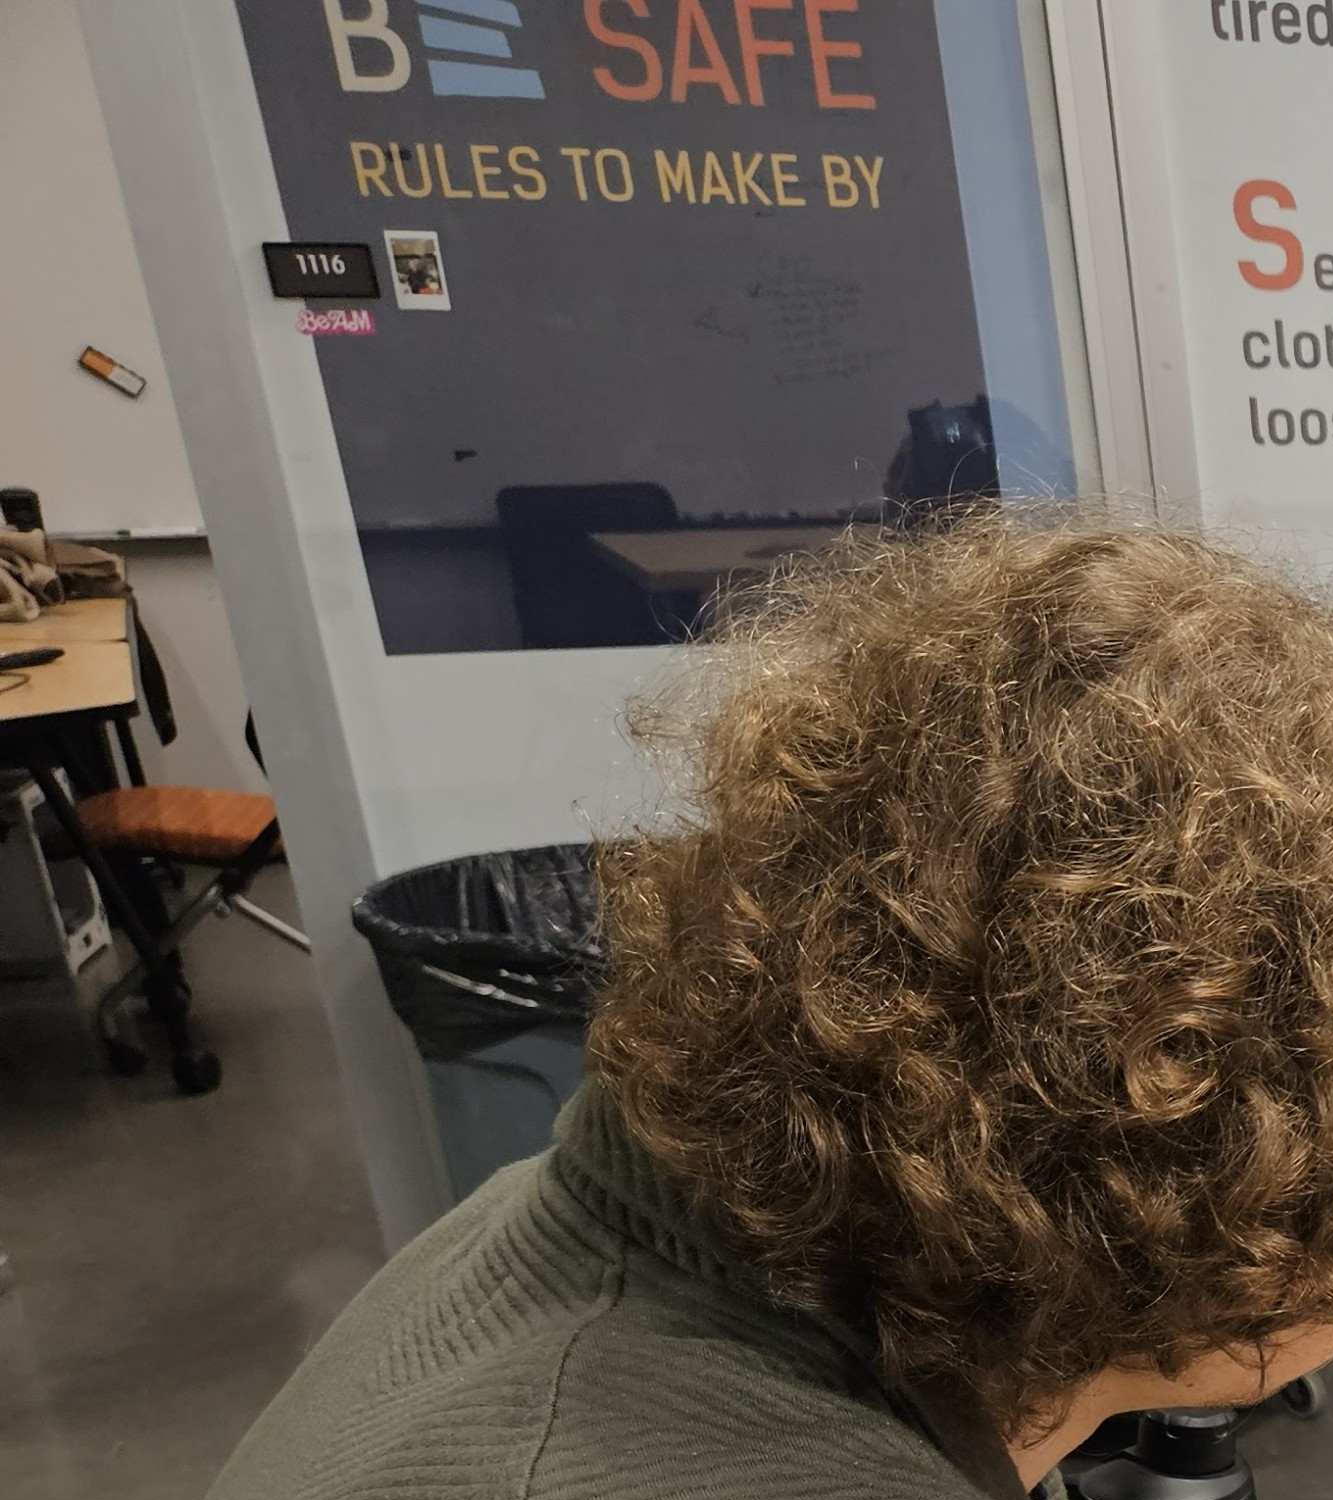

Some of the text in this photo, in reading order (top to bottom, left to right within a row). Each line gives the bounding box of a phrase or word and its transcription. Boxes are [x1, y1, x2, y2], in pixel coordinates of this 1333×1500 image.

[583, 0, 876, 110] SAFE
[350, 141, 885, 210] RULES TO MAKE BY
[295, 253, 347, 276] 1116
